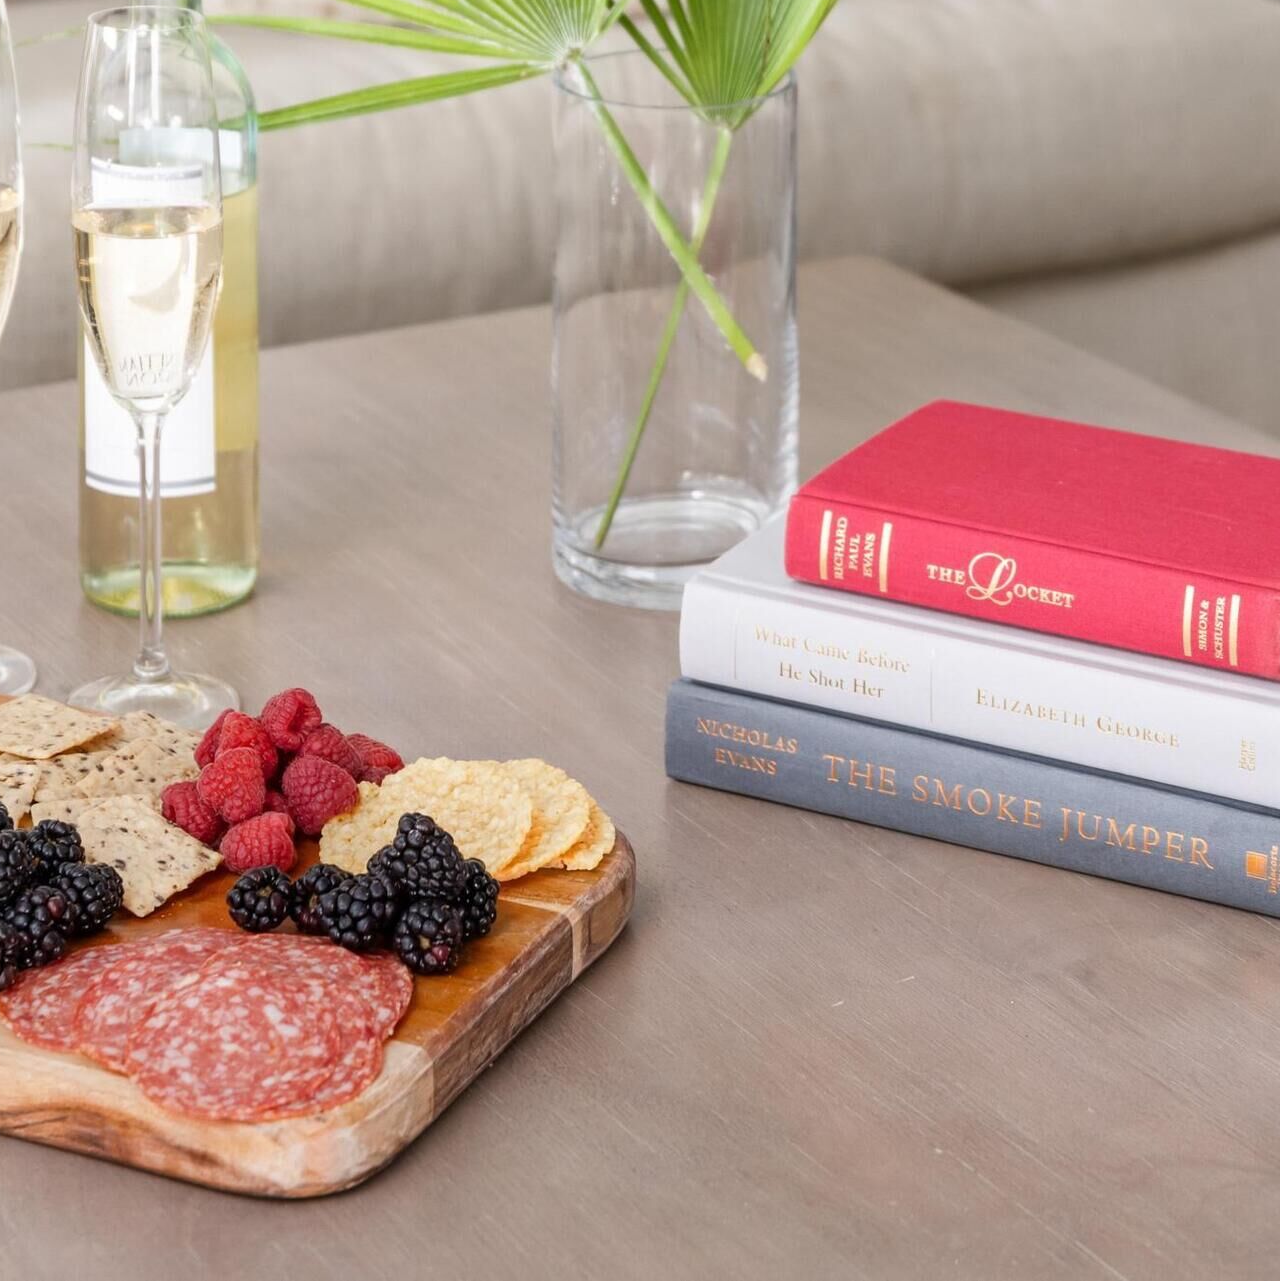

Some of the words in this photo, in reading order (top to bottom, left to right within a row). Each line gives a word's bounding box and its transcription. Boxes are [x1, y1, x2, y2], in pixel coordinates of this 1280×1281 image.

[833, 517, 848, 580] RICHARD
[847, 533, 861, 571] PAUL
[863, 532, 876, 578] EVANS
[926, 564, 966, 586] THE
[1200, 600, 1210, 610] &
[754, 623, 797, 649] What
[804, 638, 850, 662] Came
[857, 647, 910, 673] Before
[1198, 608, 1208, 651] SIMON
[1214, 596, 1226, 659] SCHUSTER
[779, 662, 802, 681] He
[808, 669, 845, 690] Shot
[853, 677, 885, 699] Her
[696, 717, 798, 755] NICHOLAS
[976, 688, 1086, 728] ELIZABETH
[1096, 714, 1180, 748] GEORGE
[715, 748, 777, 776] EVANS
[822, 753, 898, 796] THE
[911, 774, 1042, 830] SMOKE
[1057, 806, 1215, 870] JUMPER
